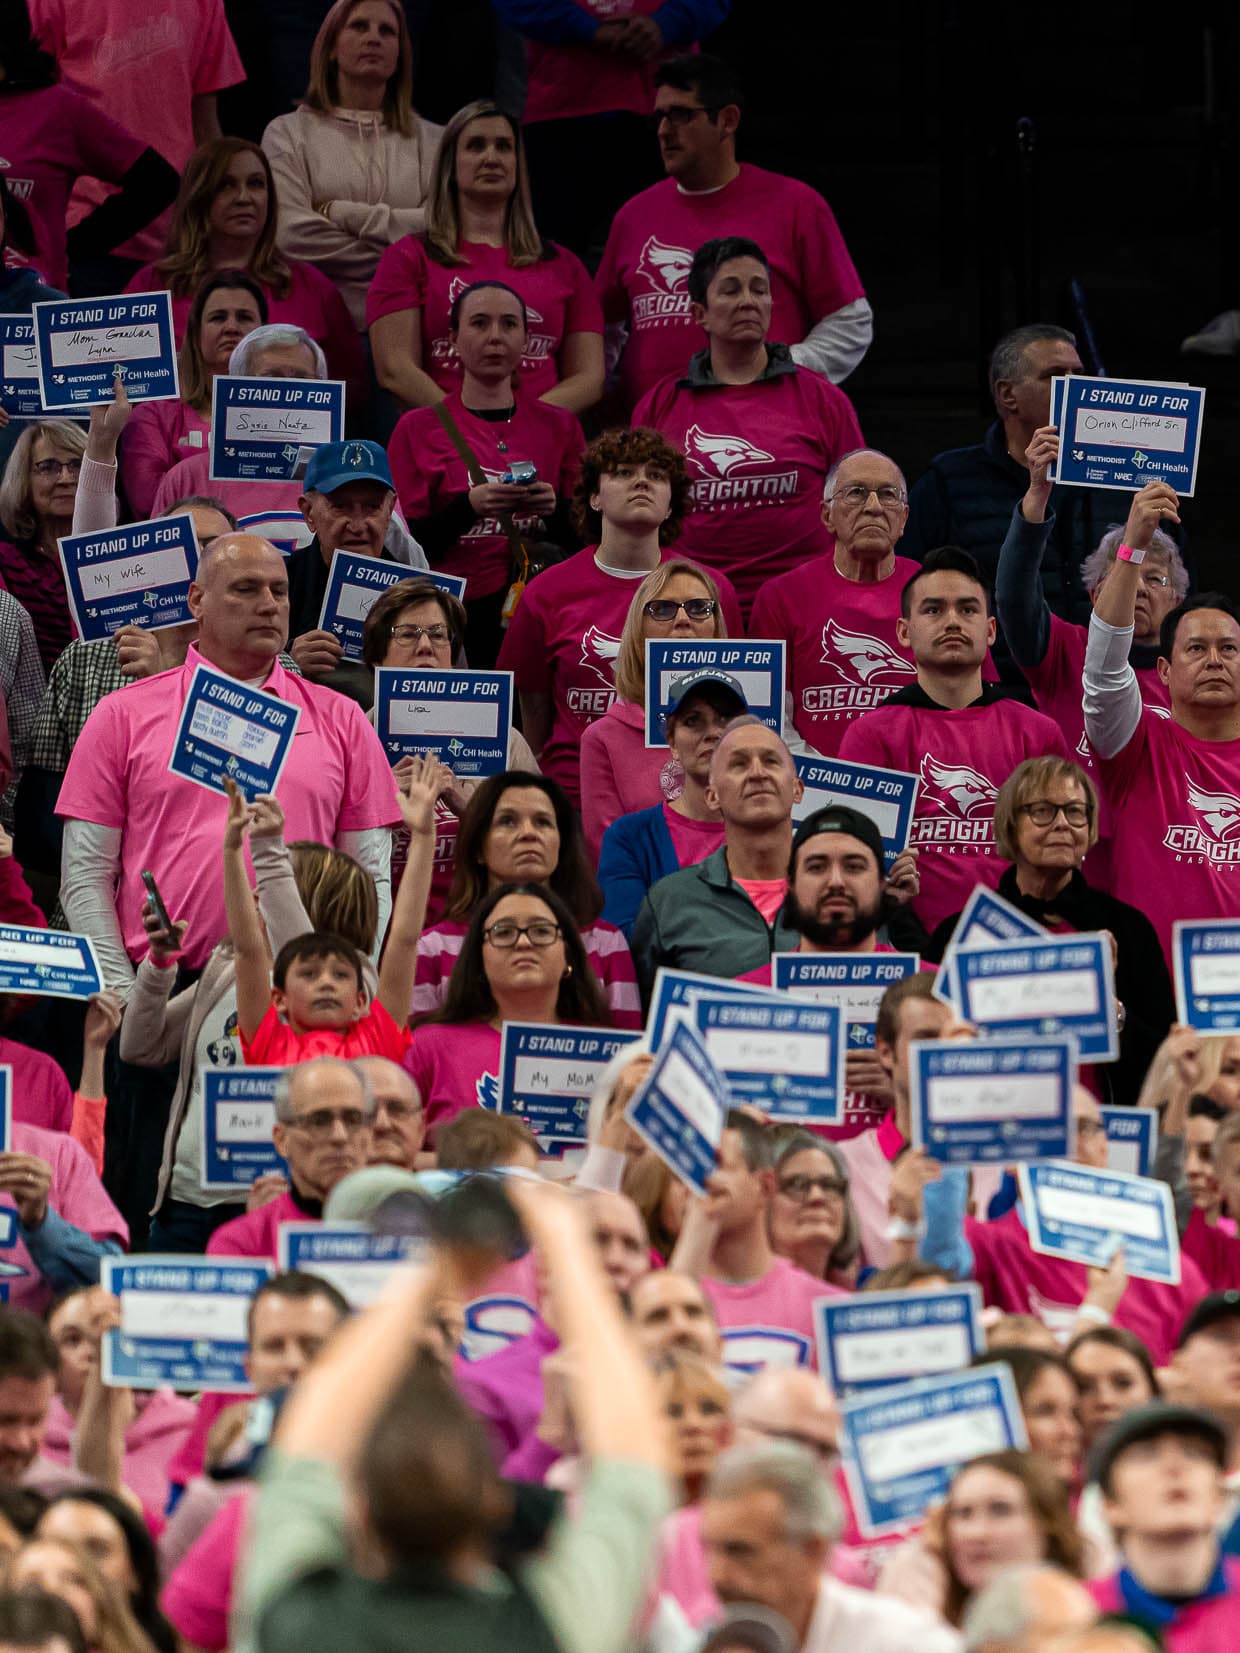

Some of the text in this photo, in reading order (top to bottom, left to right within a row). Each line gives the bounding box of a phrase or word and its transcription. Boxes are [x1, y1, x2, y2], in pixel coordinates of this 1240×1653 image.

[51, 304, 157, 325] I STAND UP FOR
[634, 296, 692, 319] CREIGH
[5, 325, 35, 337] I STA
[68, 333, 98, 346] Mom
[68, 369, 169, 382] METHODIST CHI Health
[229, 388, 331, 404] I STAND UP FOR
[1081, 389, 1189, 411] I STAND UP FOR
[1085, 416, 1117, 429] Orion
[1086, 456, 1188, 473] METHODIST CHI Health
[1114, 472, 1132, 480] NABC
[77, 528, 180, 560] I STAND UP FOR
[94, 575, 110, 588] My
[347, 565, 399, 584] I STAND
[100, 596, 174, 616] METHODIST CHI
[662, 651, 771, 664] I STAND UP FOR
[681, 670, 733, 685] BLUEJAYS
[392, 680, 499, 695] I STAND UP FOR
[202, 681, 287, 727] I STAND UP FOR
[568, 691, 615, 712] CREI
[462, 748, 476, 757] CHI
[478, 750, 503, 758] Health
[808, 768, 903, 796] STAND UP FOR
[910, 821, 995, 841] CREIGH
[26, 934, 44, 942] UP
[50, 936, 76, 946] FOR
[790, 965, 904, 980] I STAND UP FOR
[519, 1035, 599, 1054] I STAND UP
